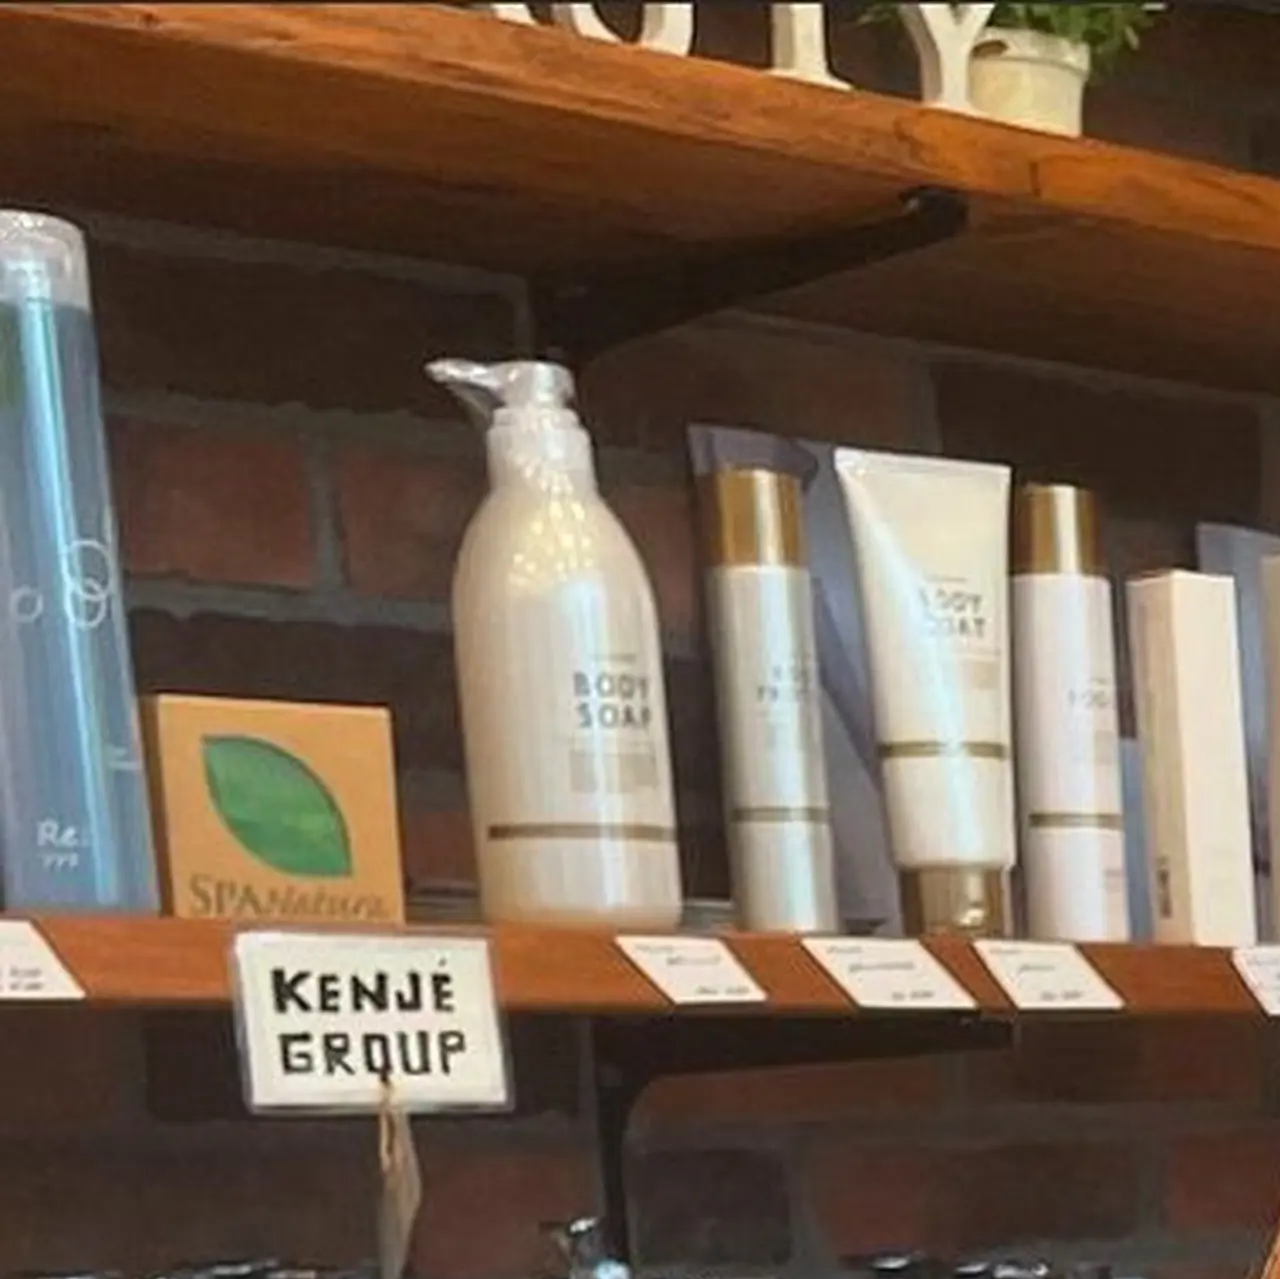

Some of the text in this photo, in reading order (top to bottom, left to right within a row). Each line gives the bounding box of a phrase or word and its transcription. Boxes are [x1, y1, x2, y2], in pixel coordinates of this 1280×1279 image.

[572, 671, 648, 698] BODY
[575, 702, 653, 728] SOAP
[280, 1031, 467, 1081] GROUP
